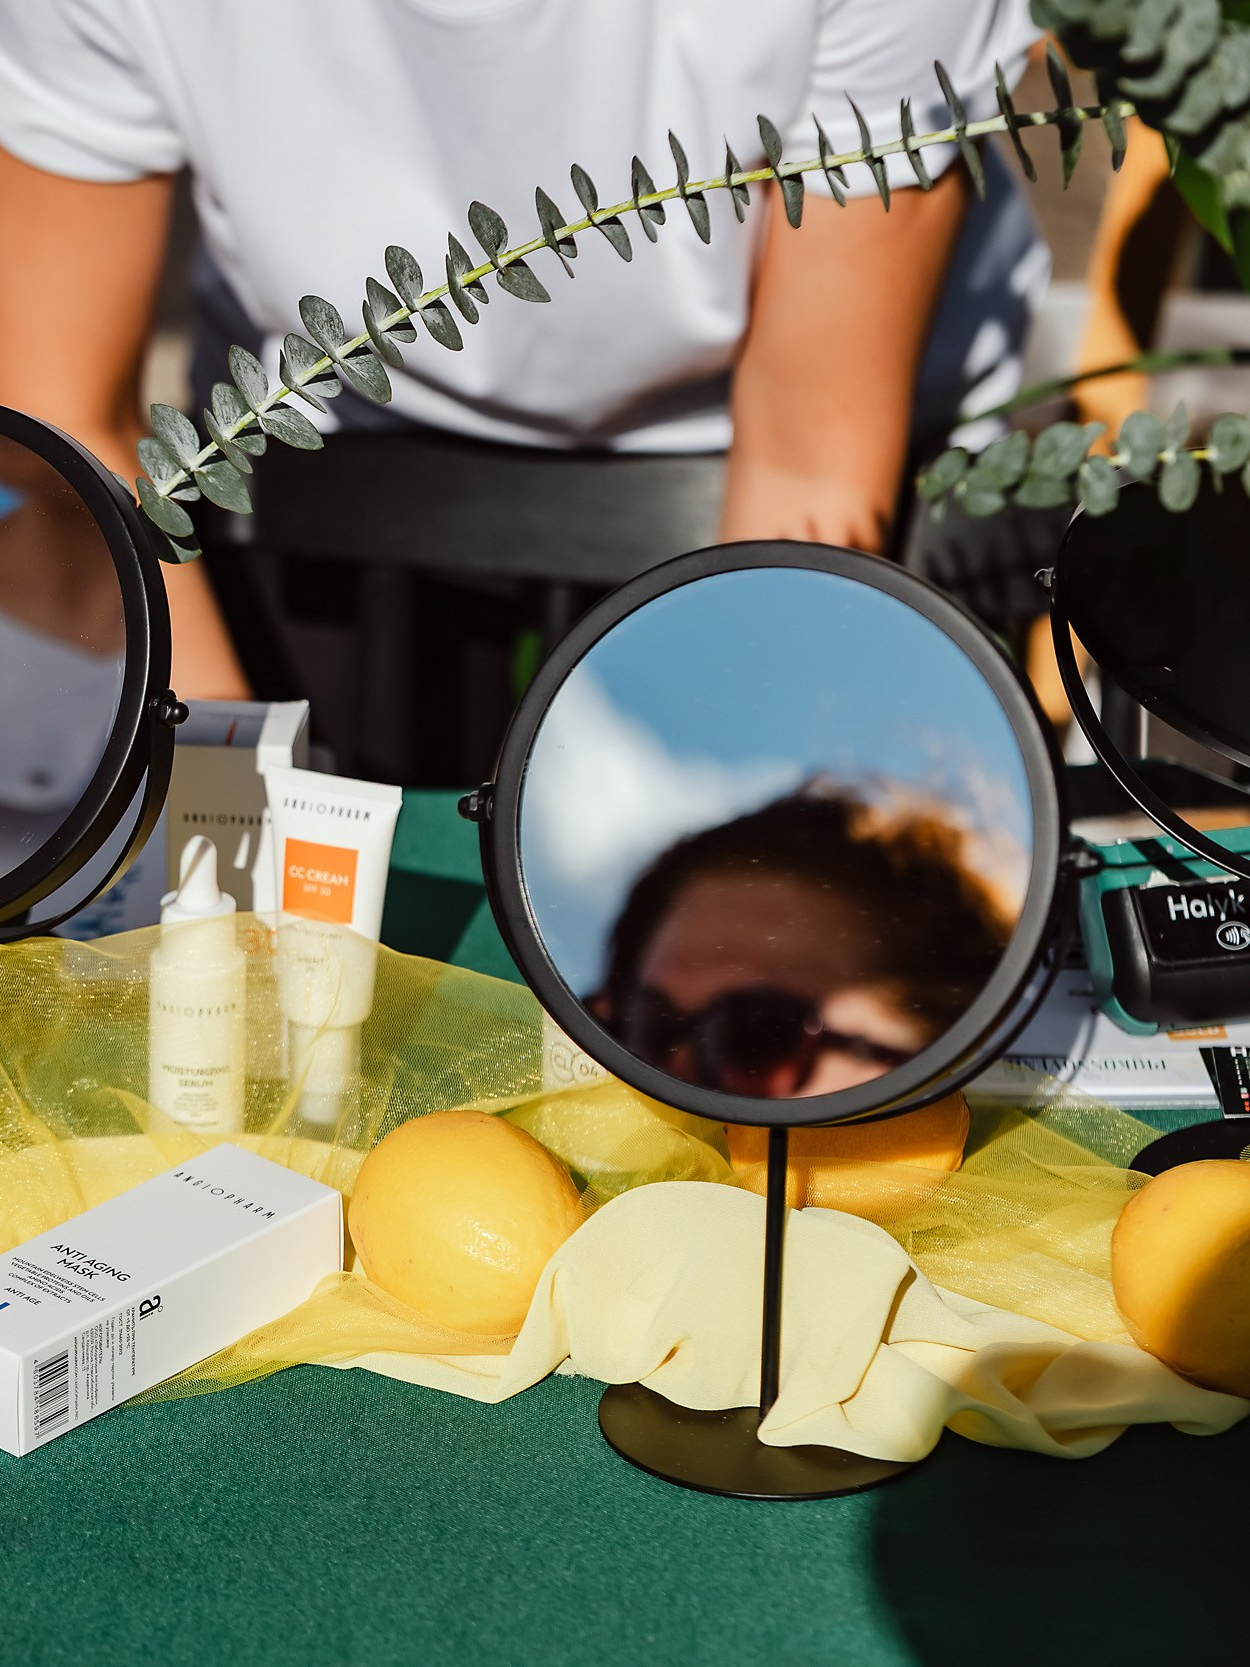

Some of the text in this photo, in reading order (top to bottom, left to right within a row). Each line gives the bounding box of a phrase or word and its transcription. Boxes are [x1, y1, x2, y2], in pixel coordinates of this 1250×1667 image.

[288, 864, 350, 887] CC CREAM
[302, 882, 318, 894] SPF
[1166, 888, 1247, 922] Halyk
[173, 1171, 276, 1220] ANGIOPHARM
[50, 1244, 132, 1282] ANTI AGING
[56, 1258, 100, 1280] MASK
[8, 1272, 35, 1286] COMPLEX
[42, 1287, 73, 1304] EXTRACTS
[11, 1261, 95, 1303] VEGETABLE PROTEINS AND OILS
[12, 1257, 106, 1302] MOUNTAIN EDELWEISS STEM CELLS
[27, 1275, 65, 1294] AMINO ACIDS
[3, 1287, 42, 1306] ANTI AGE
